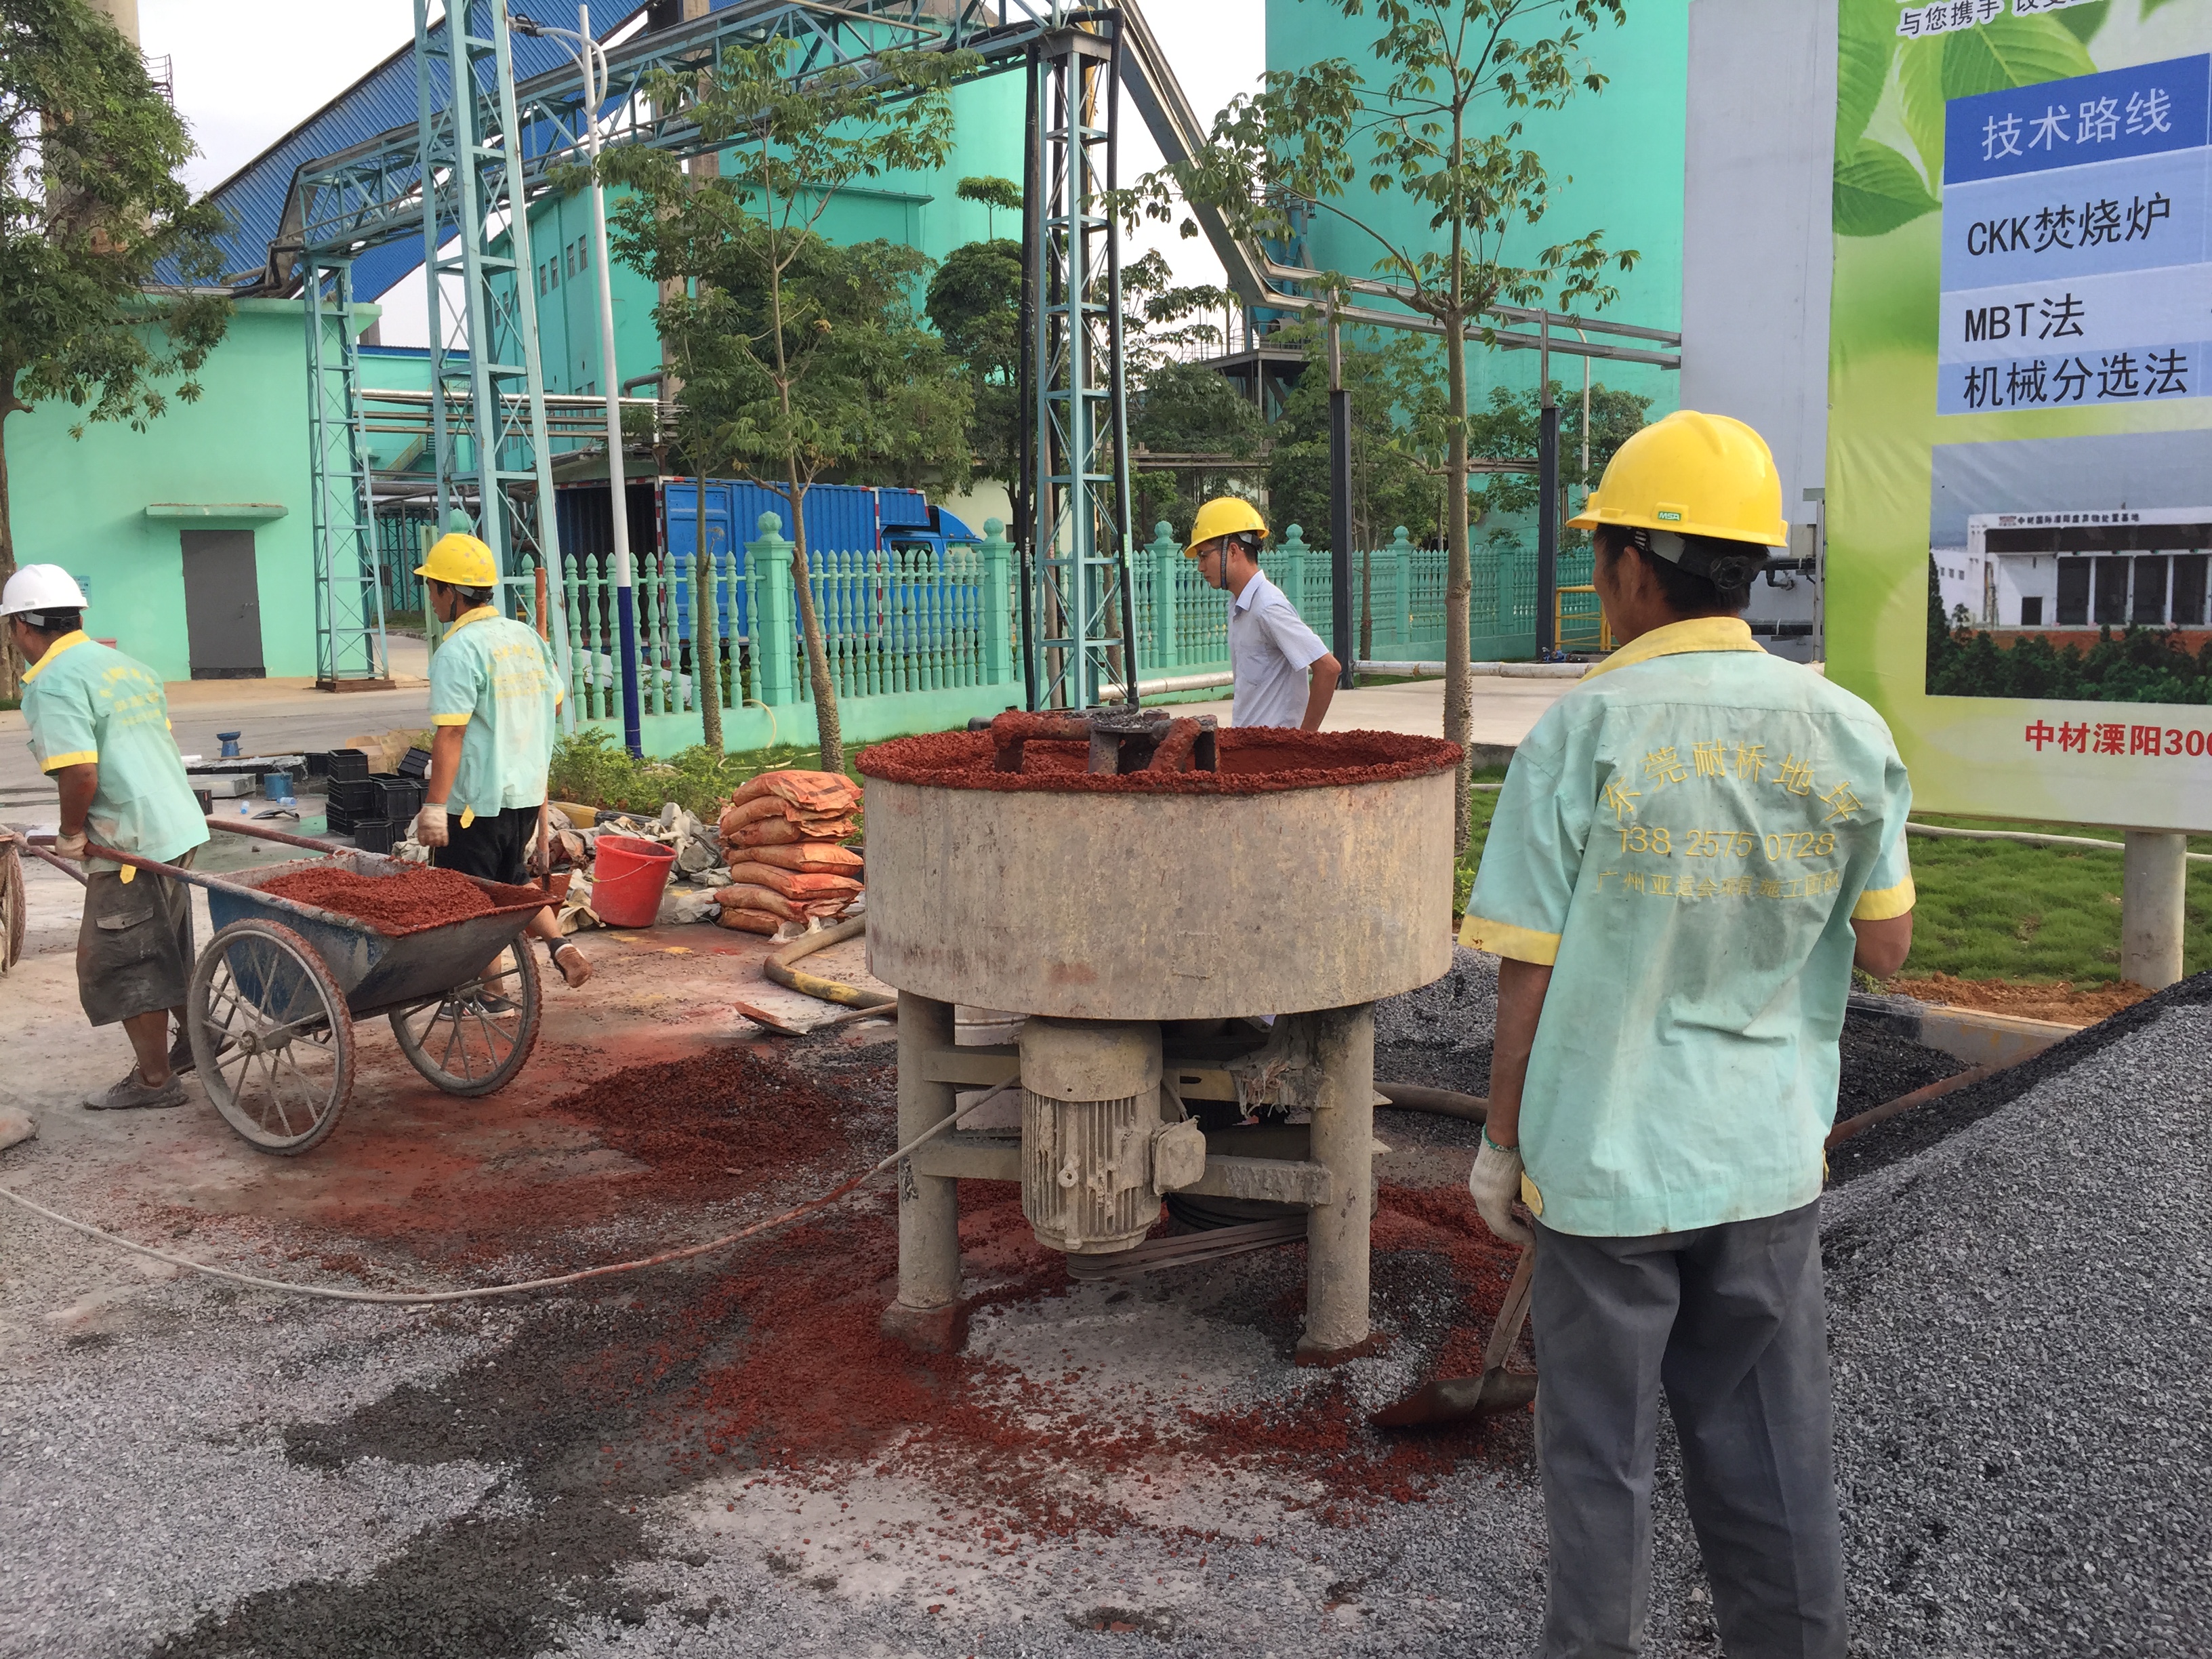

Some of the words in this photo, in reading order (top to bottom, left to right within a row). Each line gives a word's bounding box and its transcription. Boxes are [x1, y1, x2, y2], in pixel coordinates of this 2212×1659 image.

[1900, 0, 2000, 35] 与您携手
[1982, 87, 2172, 161] 技术路线
[1967, 191, 2171, 256] CKK焚烧炉
[1964, 293, 2085, 342] MBT法
[1963, 348, 2188, 409] 机械分选法
[1658, 512, 1680, 520] MSA
[2025, 719, 2212, 758] 中材溧阳30
[1599, 738, 1864, 821] 东莞耐桥地坪
[1618, 827, 1672, 855] 138
[1685, 830, 1755, 858] 2575
[1765, 831, 1836, 861] 0728
